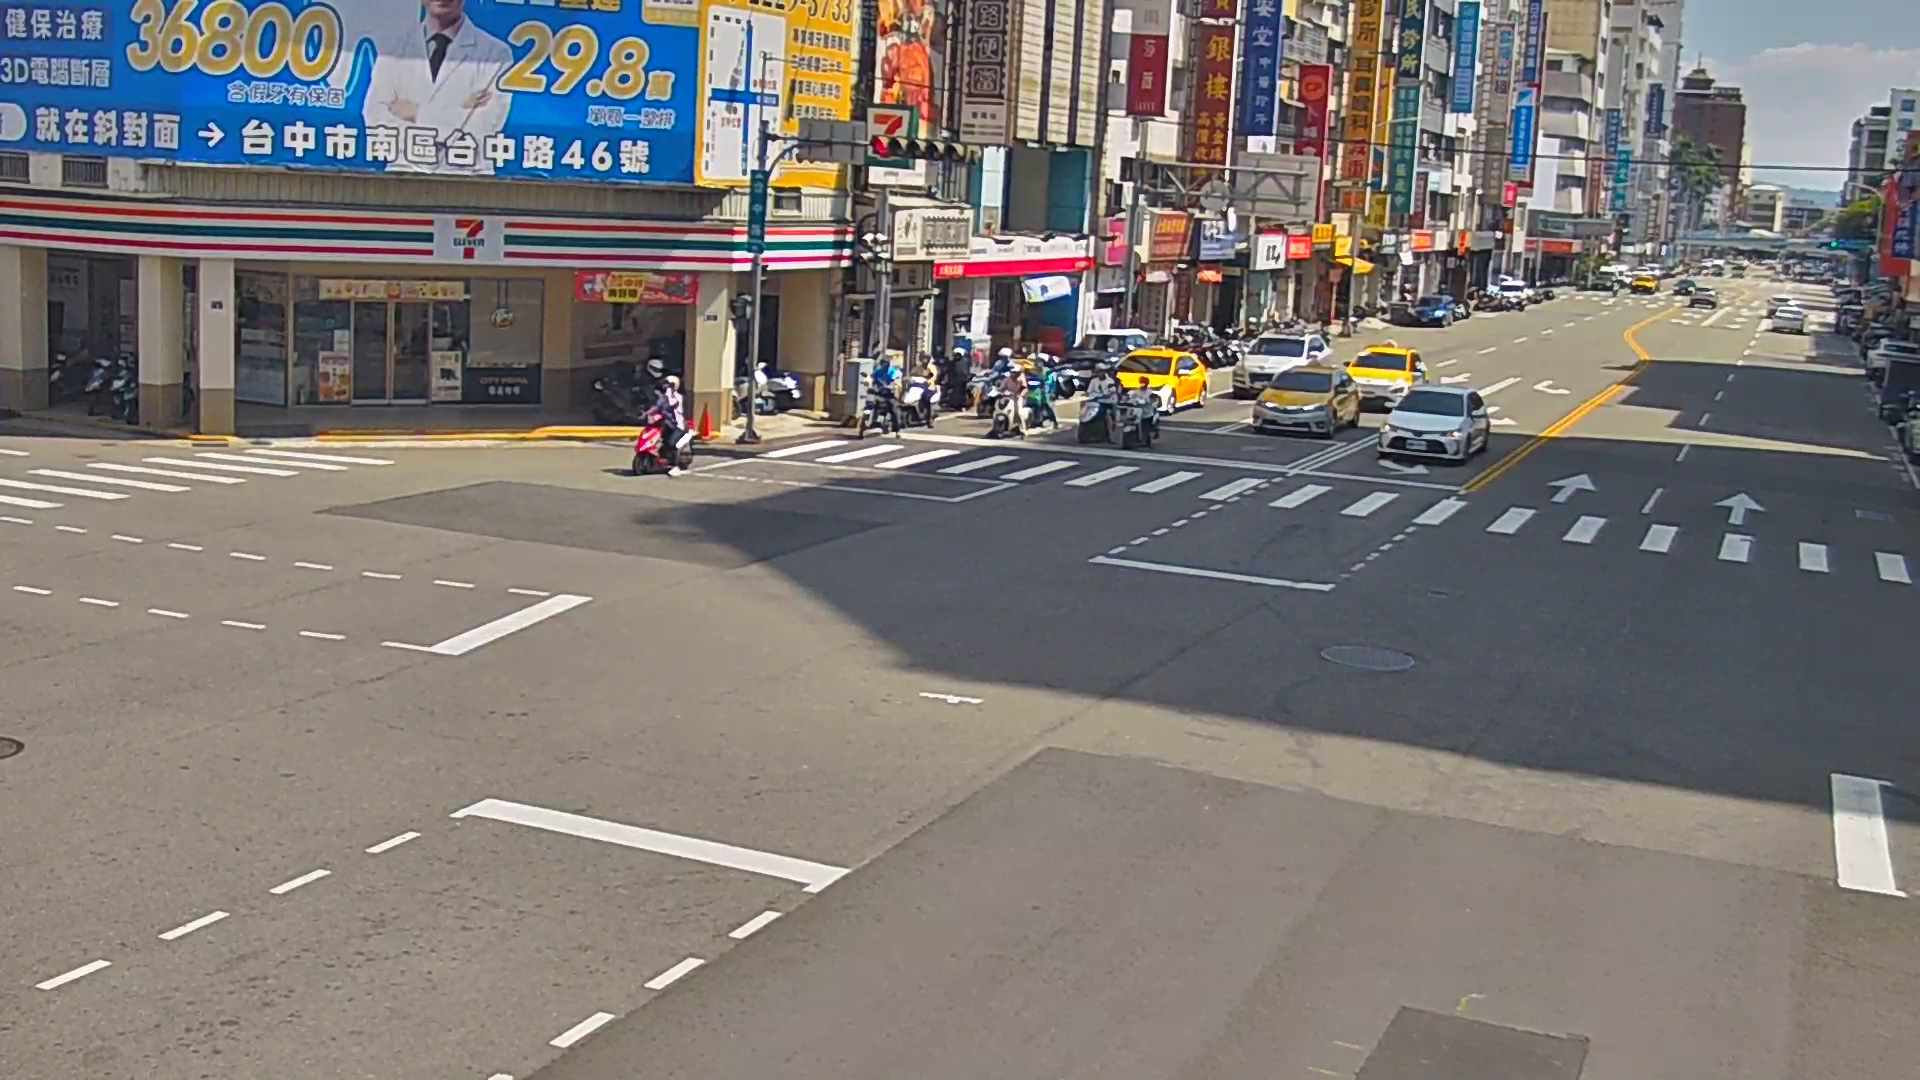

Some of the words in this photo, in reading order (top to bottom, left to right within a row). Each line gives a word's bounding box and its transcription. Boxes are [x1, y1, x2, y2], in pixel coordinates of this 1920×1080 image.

[5, 9, 104, 40] 健保治療
[126, 0, 342, 82] 36800
[0, 56, 112, 88] 3D電腦斷層
[36, 107, 181, 150] 就在斜對面
[242, 119, 651, 174] 台中市南區台中路46號
